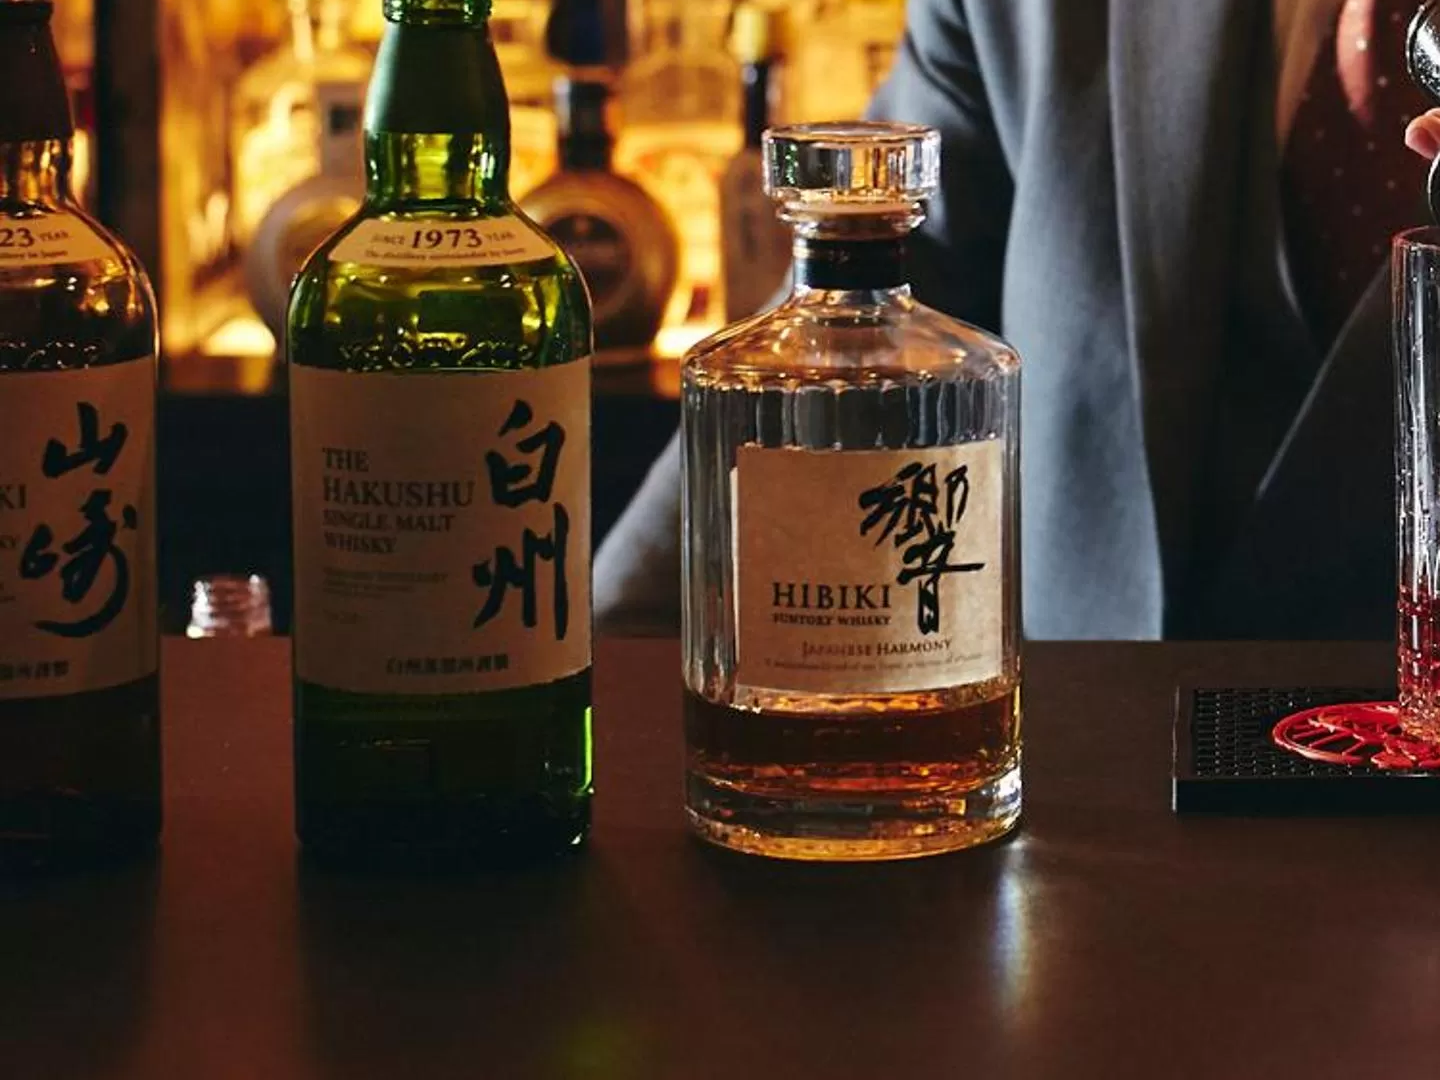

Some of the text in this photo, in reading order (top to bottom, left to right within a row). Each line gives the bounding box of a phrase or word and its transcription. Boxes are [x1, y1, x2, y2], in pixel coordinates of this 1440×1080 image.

[411, 228, 483, 249] 1973
[322, 447, 370, 472] THE
[322, 475, 476, 508] HAKUSHU
[396, 512, 456, 532] MALT
[472, 398, 569, 641] 白州
[858, 461, 985, 635] 響
[772, 581, 892, 610] HIBIKI
